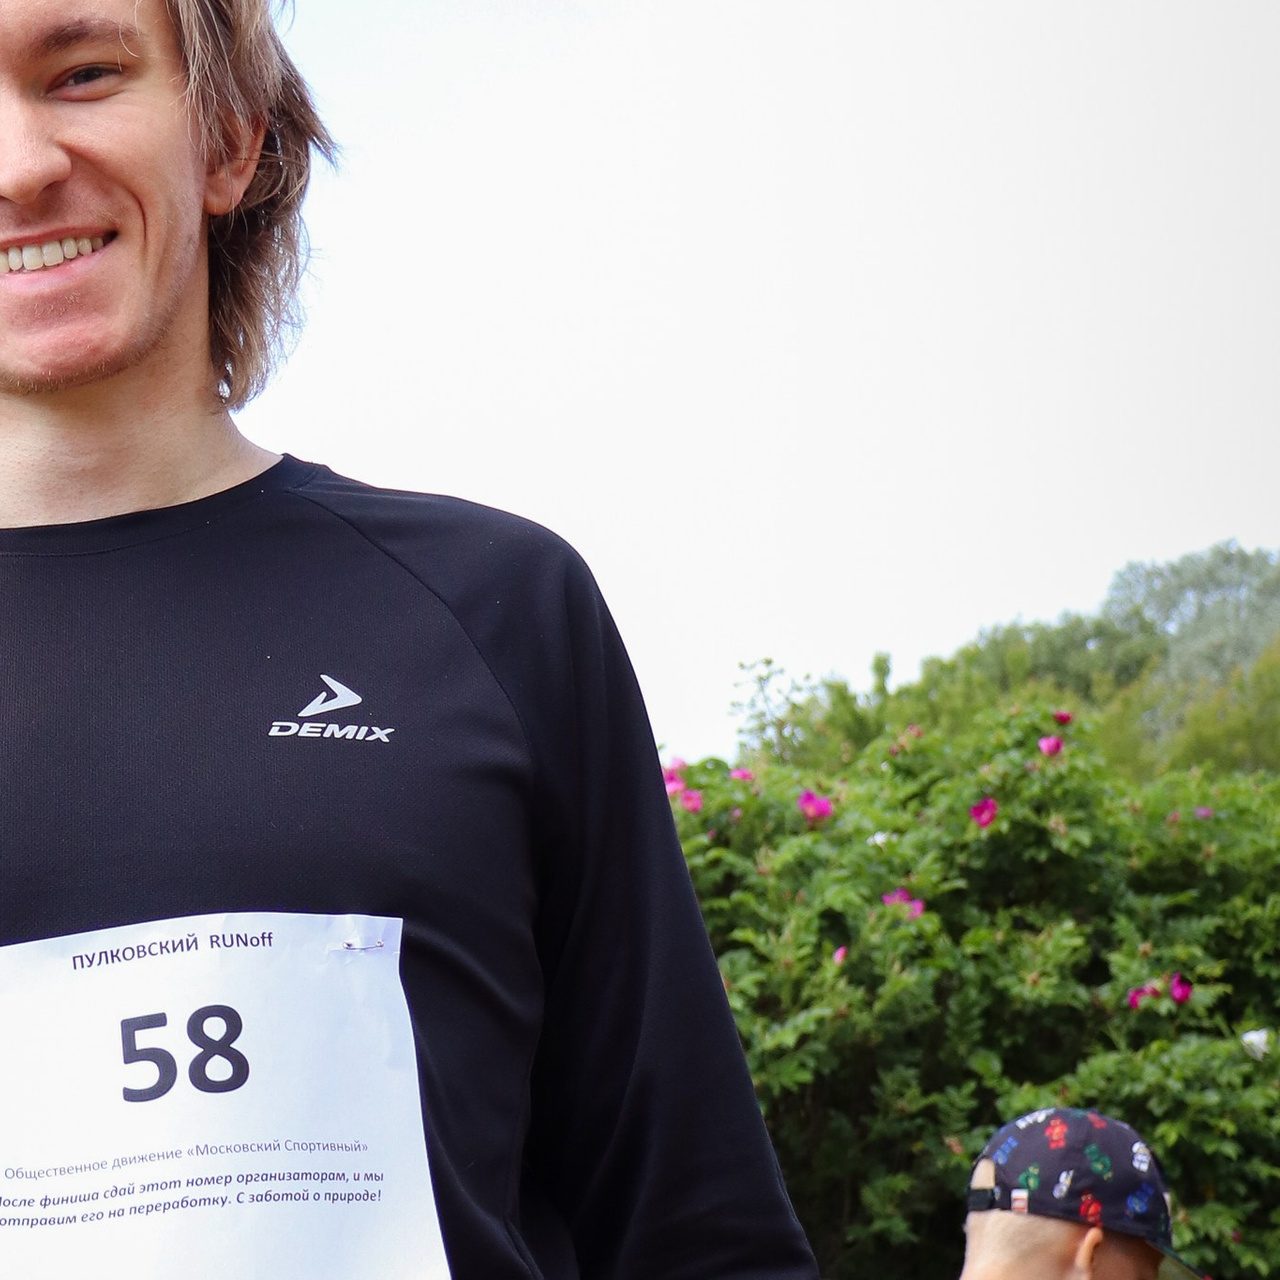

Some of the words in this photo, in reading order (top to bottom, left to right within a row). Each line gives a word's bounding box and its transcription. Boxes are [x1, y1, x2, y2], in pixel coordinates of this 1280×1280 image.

[268, 721, 395, 742] DEMIX
[72, 933, 199, 970] ПУЛКОВСКИЙ
[209, 932, 274, 949] RUNoff
[120, 1004, 250, 1103] 58
[4, 1159, 108, 1180] Общественное
[111, 1148, 183, 1169] движение
[187, 1139, 281, 1157] «Московский
[284, 1139, 368, 1153] Спортивный»
[39, 1191, 100, 1209] финиша
[103, 1182, 135, 1200] сдай
[138, 1178, 182, 1194] этот
[186, 1173, 233, 1188] номер
[236, 1171, 350, 1184] организаторам,
[353, 1171, 361, 1182] и
[364, 1171, 384, 1182] мы
[81, 1210, 104, 1223] его
[108, 1207, 125, 1219] на
[129, 1195, 232, 1216] переработку.
[236, 1191, 245, 1204] С
[248, 1188, 309, 1203] заботой
[313, 1192, 320, 1202] о
[324, 1189, 382, 1204] природе!
